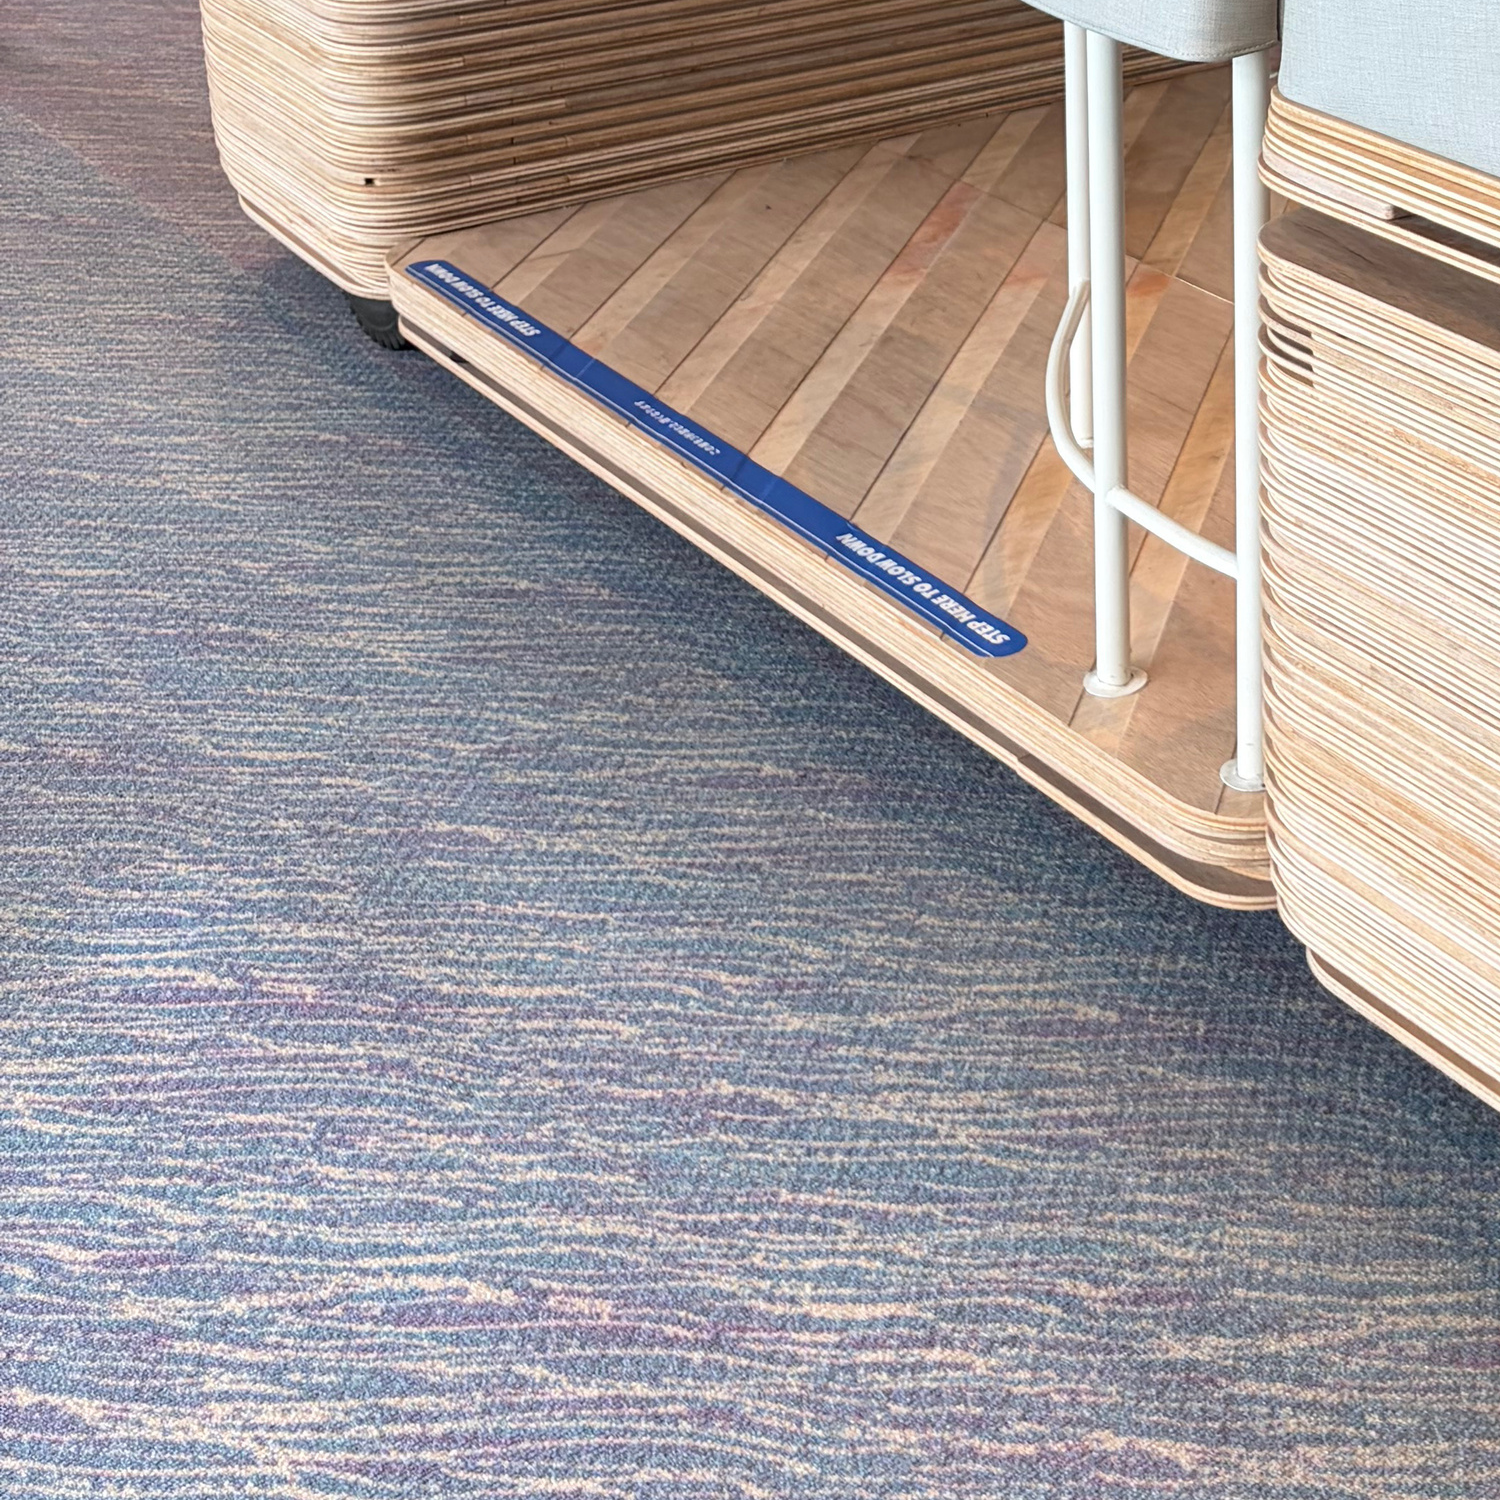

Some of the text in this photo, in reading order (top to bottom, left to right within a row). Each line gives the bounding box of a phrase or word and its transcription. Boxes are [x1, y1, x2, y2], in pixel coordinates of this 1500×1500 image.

[474, 296, 496, 308] TO
[509, 320, 541, 336] STEP
[835, 532, 1011, 645] STEP HERE TO SLOW DOWN
